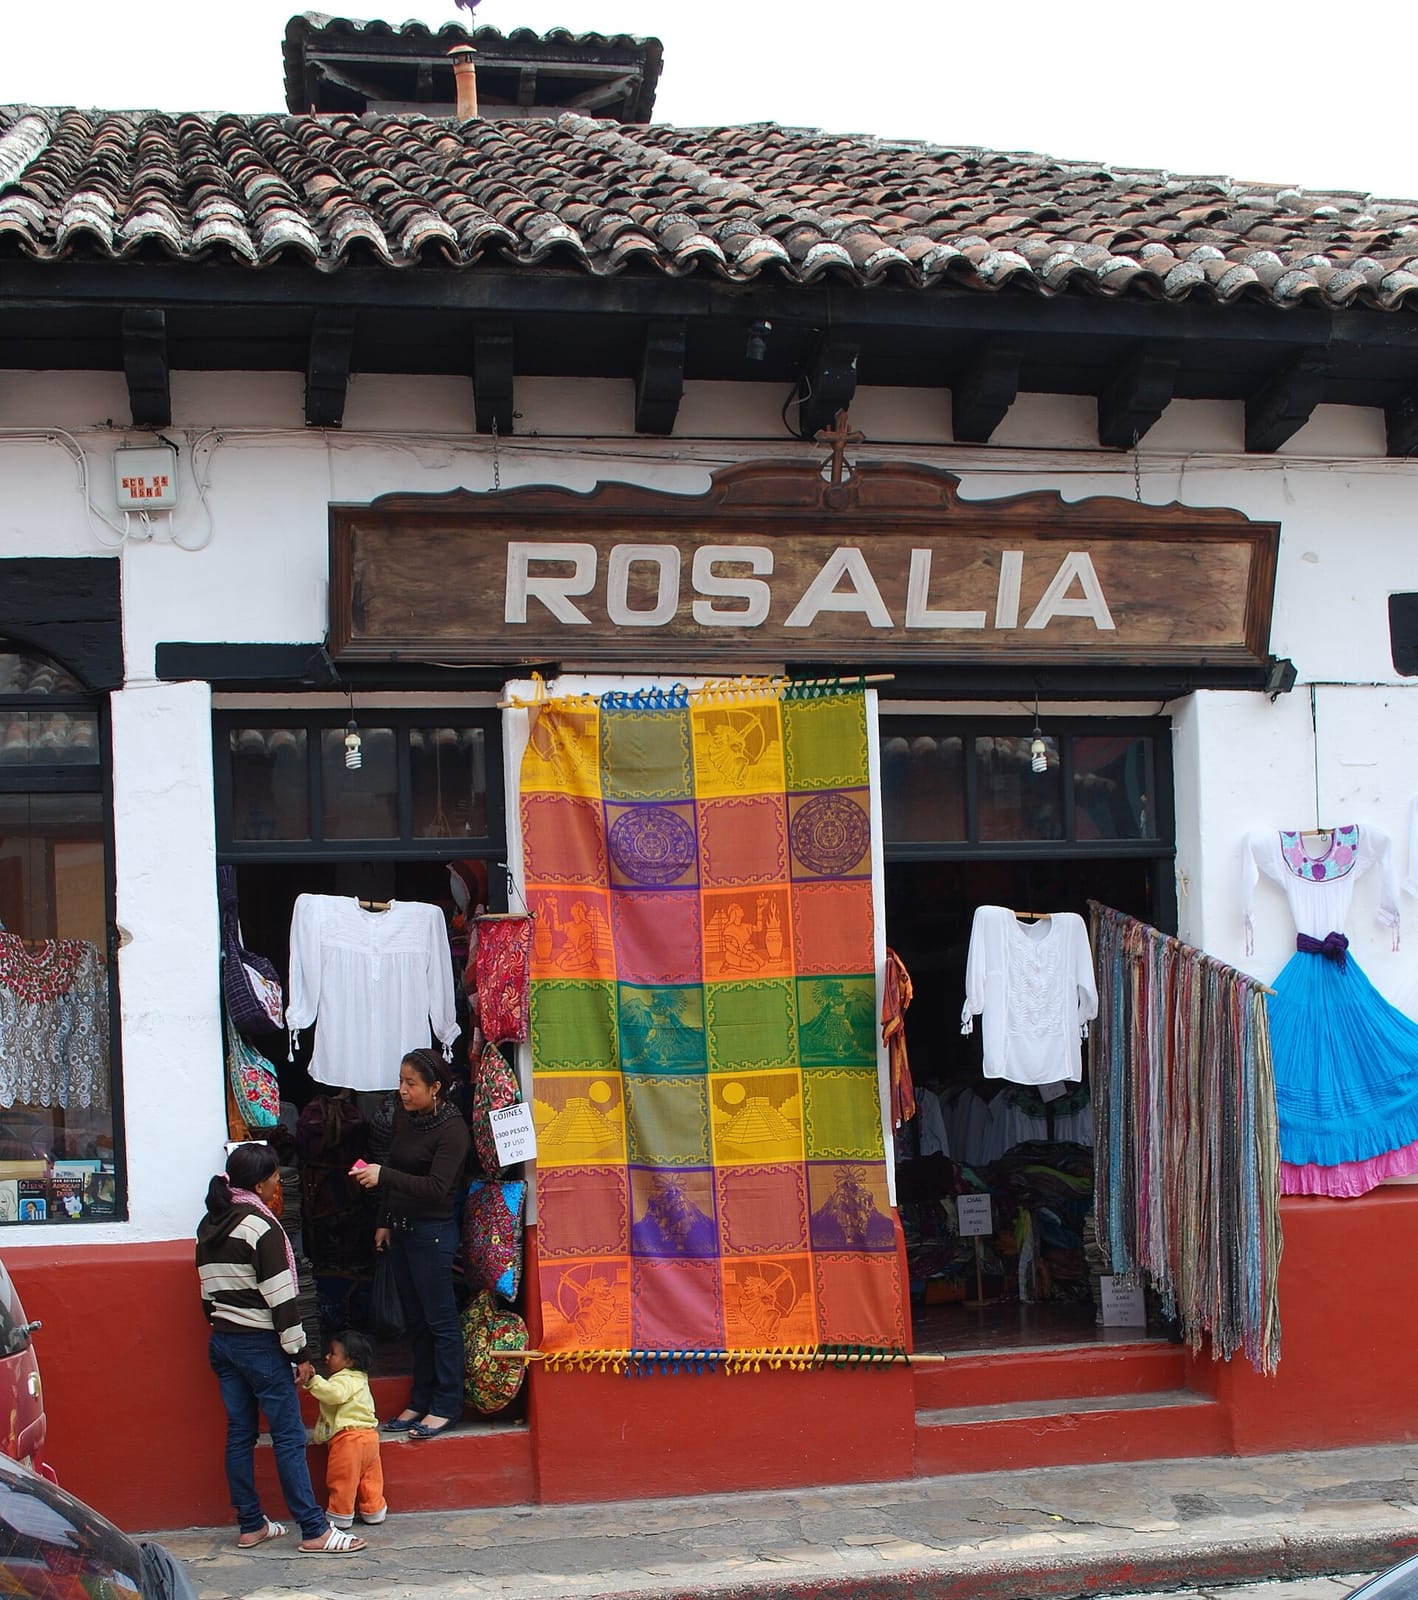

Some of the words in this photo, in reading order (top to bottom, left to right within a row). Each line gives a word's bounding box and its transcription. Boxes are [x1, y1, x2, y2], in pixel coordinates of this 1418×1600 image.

[504, 541, 1116, 630] ROSALIA
[493, 1108, 523, 1121] COJINES
[510, 1126, 529, 1135] PESOS
[512, 1138, 525, 1146] USD
